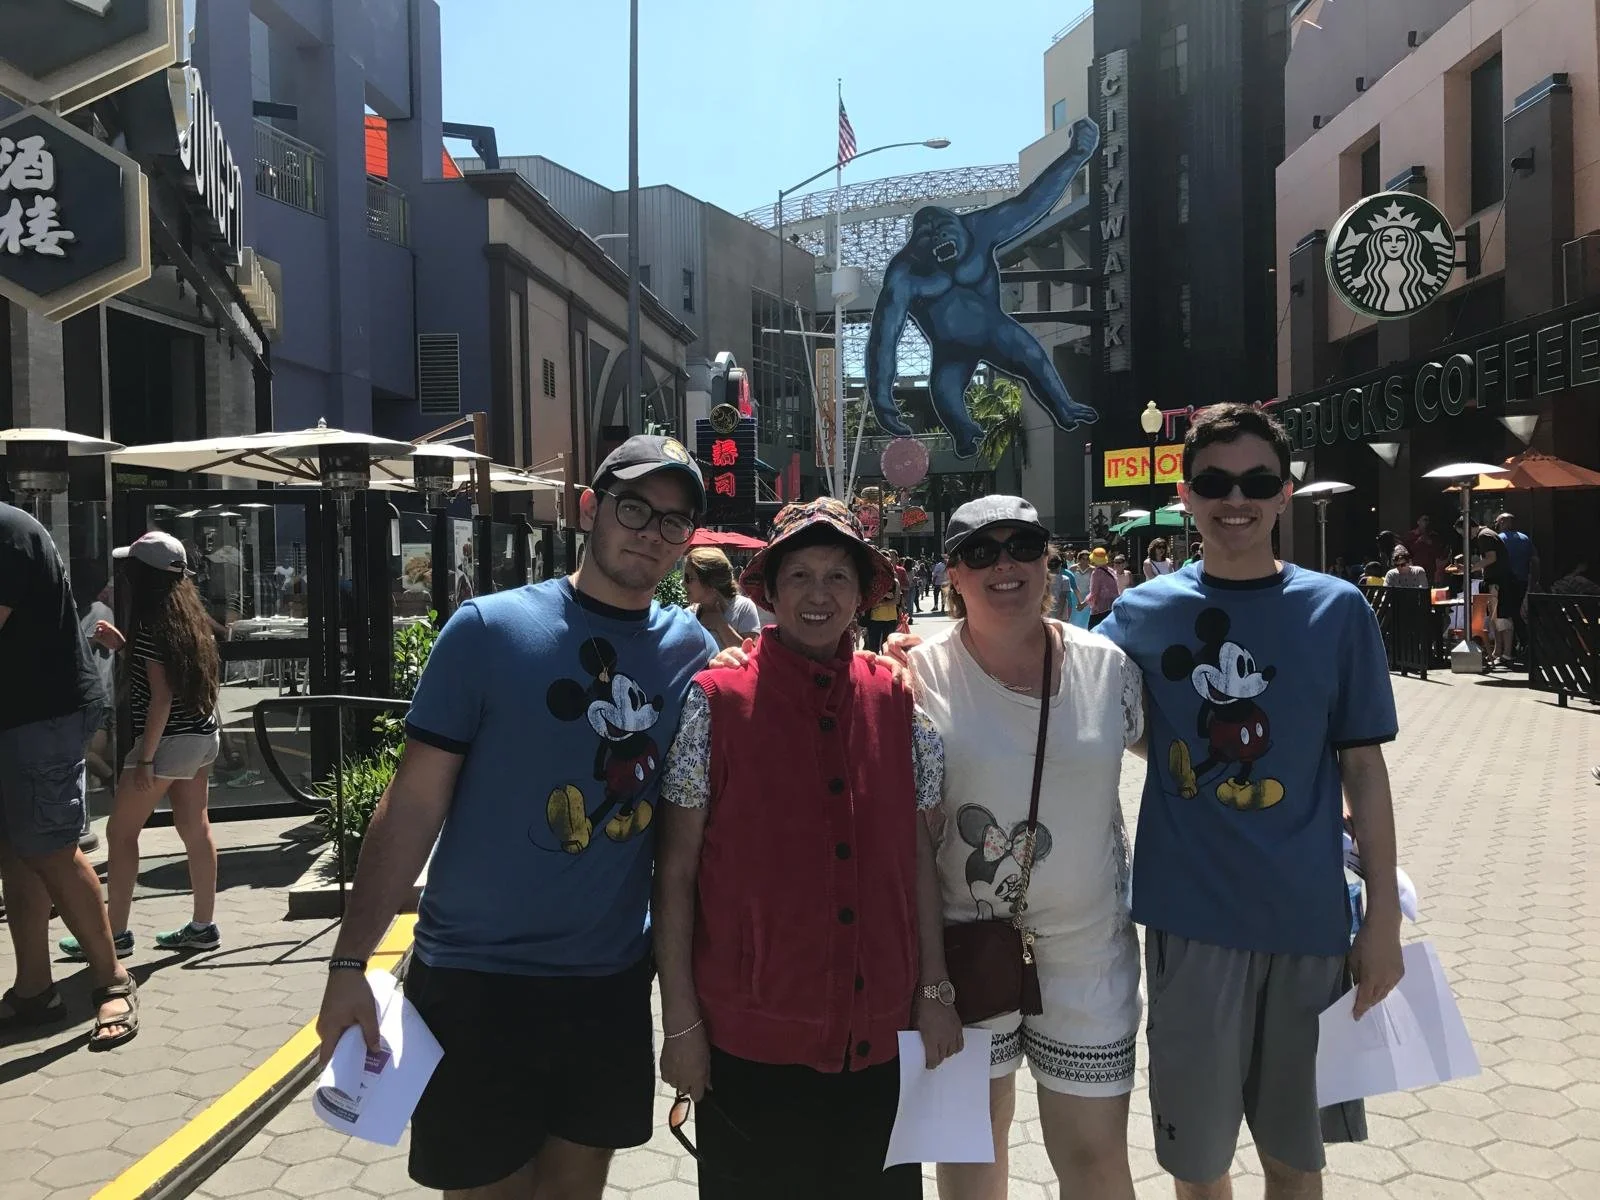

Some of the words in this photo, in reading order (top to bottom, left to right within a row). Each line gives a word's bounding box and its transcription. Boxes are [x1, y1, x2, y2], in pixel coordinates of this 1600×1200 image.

[1100, 73, 1125, 348] CITYWALK
[1284, 375, 1404, 452] RBUCKS
[1415, 312, 1600, 423] COFFEE
[1107, 456, 1138, 479] IT'S
